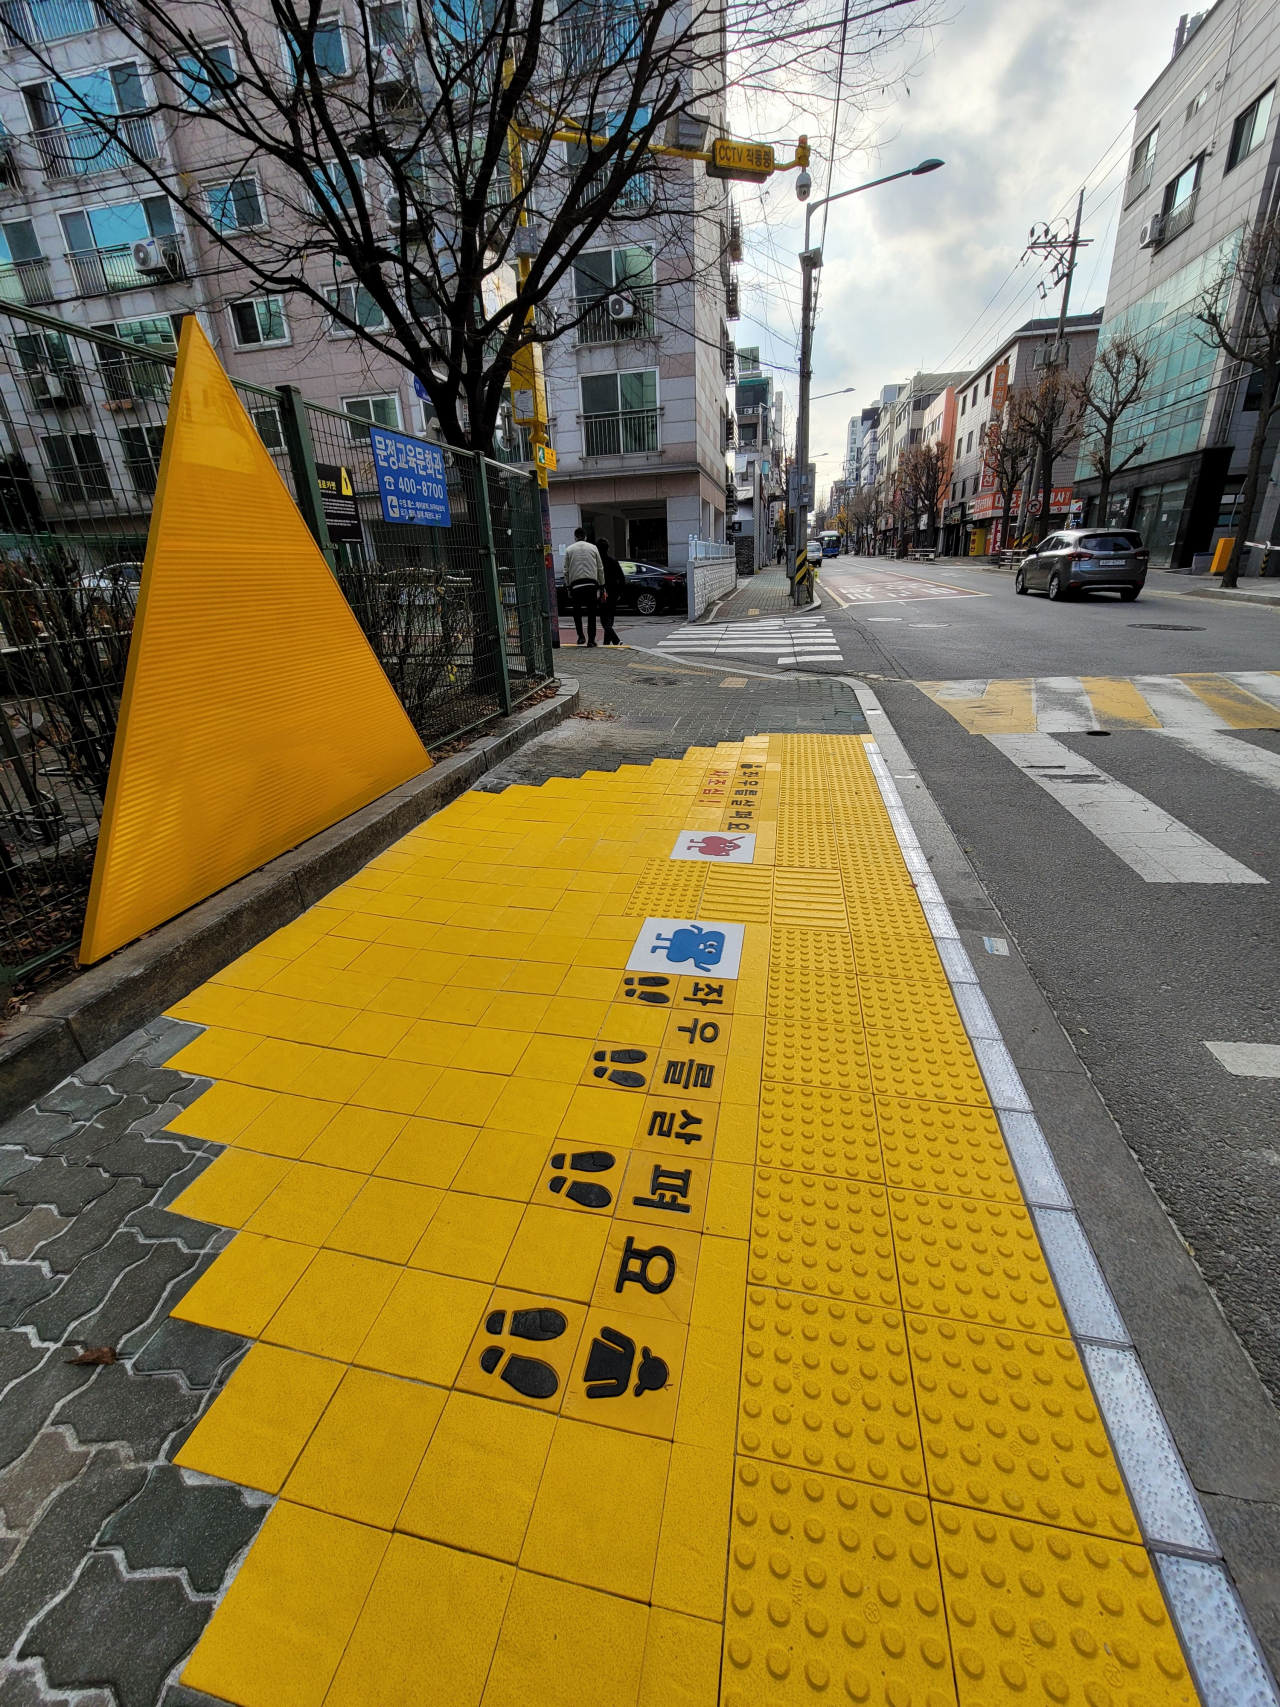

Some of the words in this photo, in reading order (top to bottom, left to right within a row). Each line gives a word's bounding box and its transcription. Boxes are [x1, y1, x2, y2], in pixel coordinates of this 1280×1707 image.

[719, 145, 743, 162] CCTV
[747, 148, 771, 168] 작동중
[375, 435, 443, 480] 문정교육문화관
[398, 476, 444, 499] 400-8700
[698, 770, 729, 803] 차조심!
